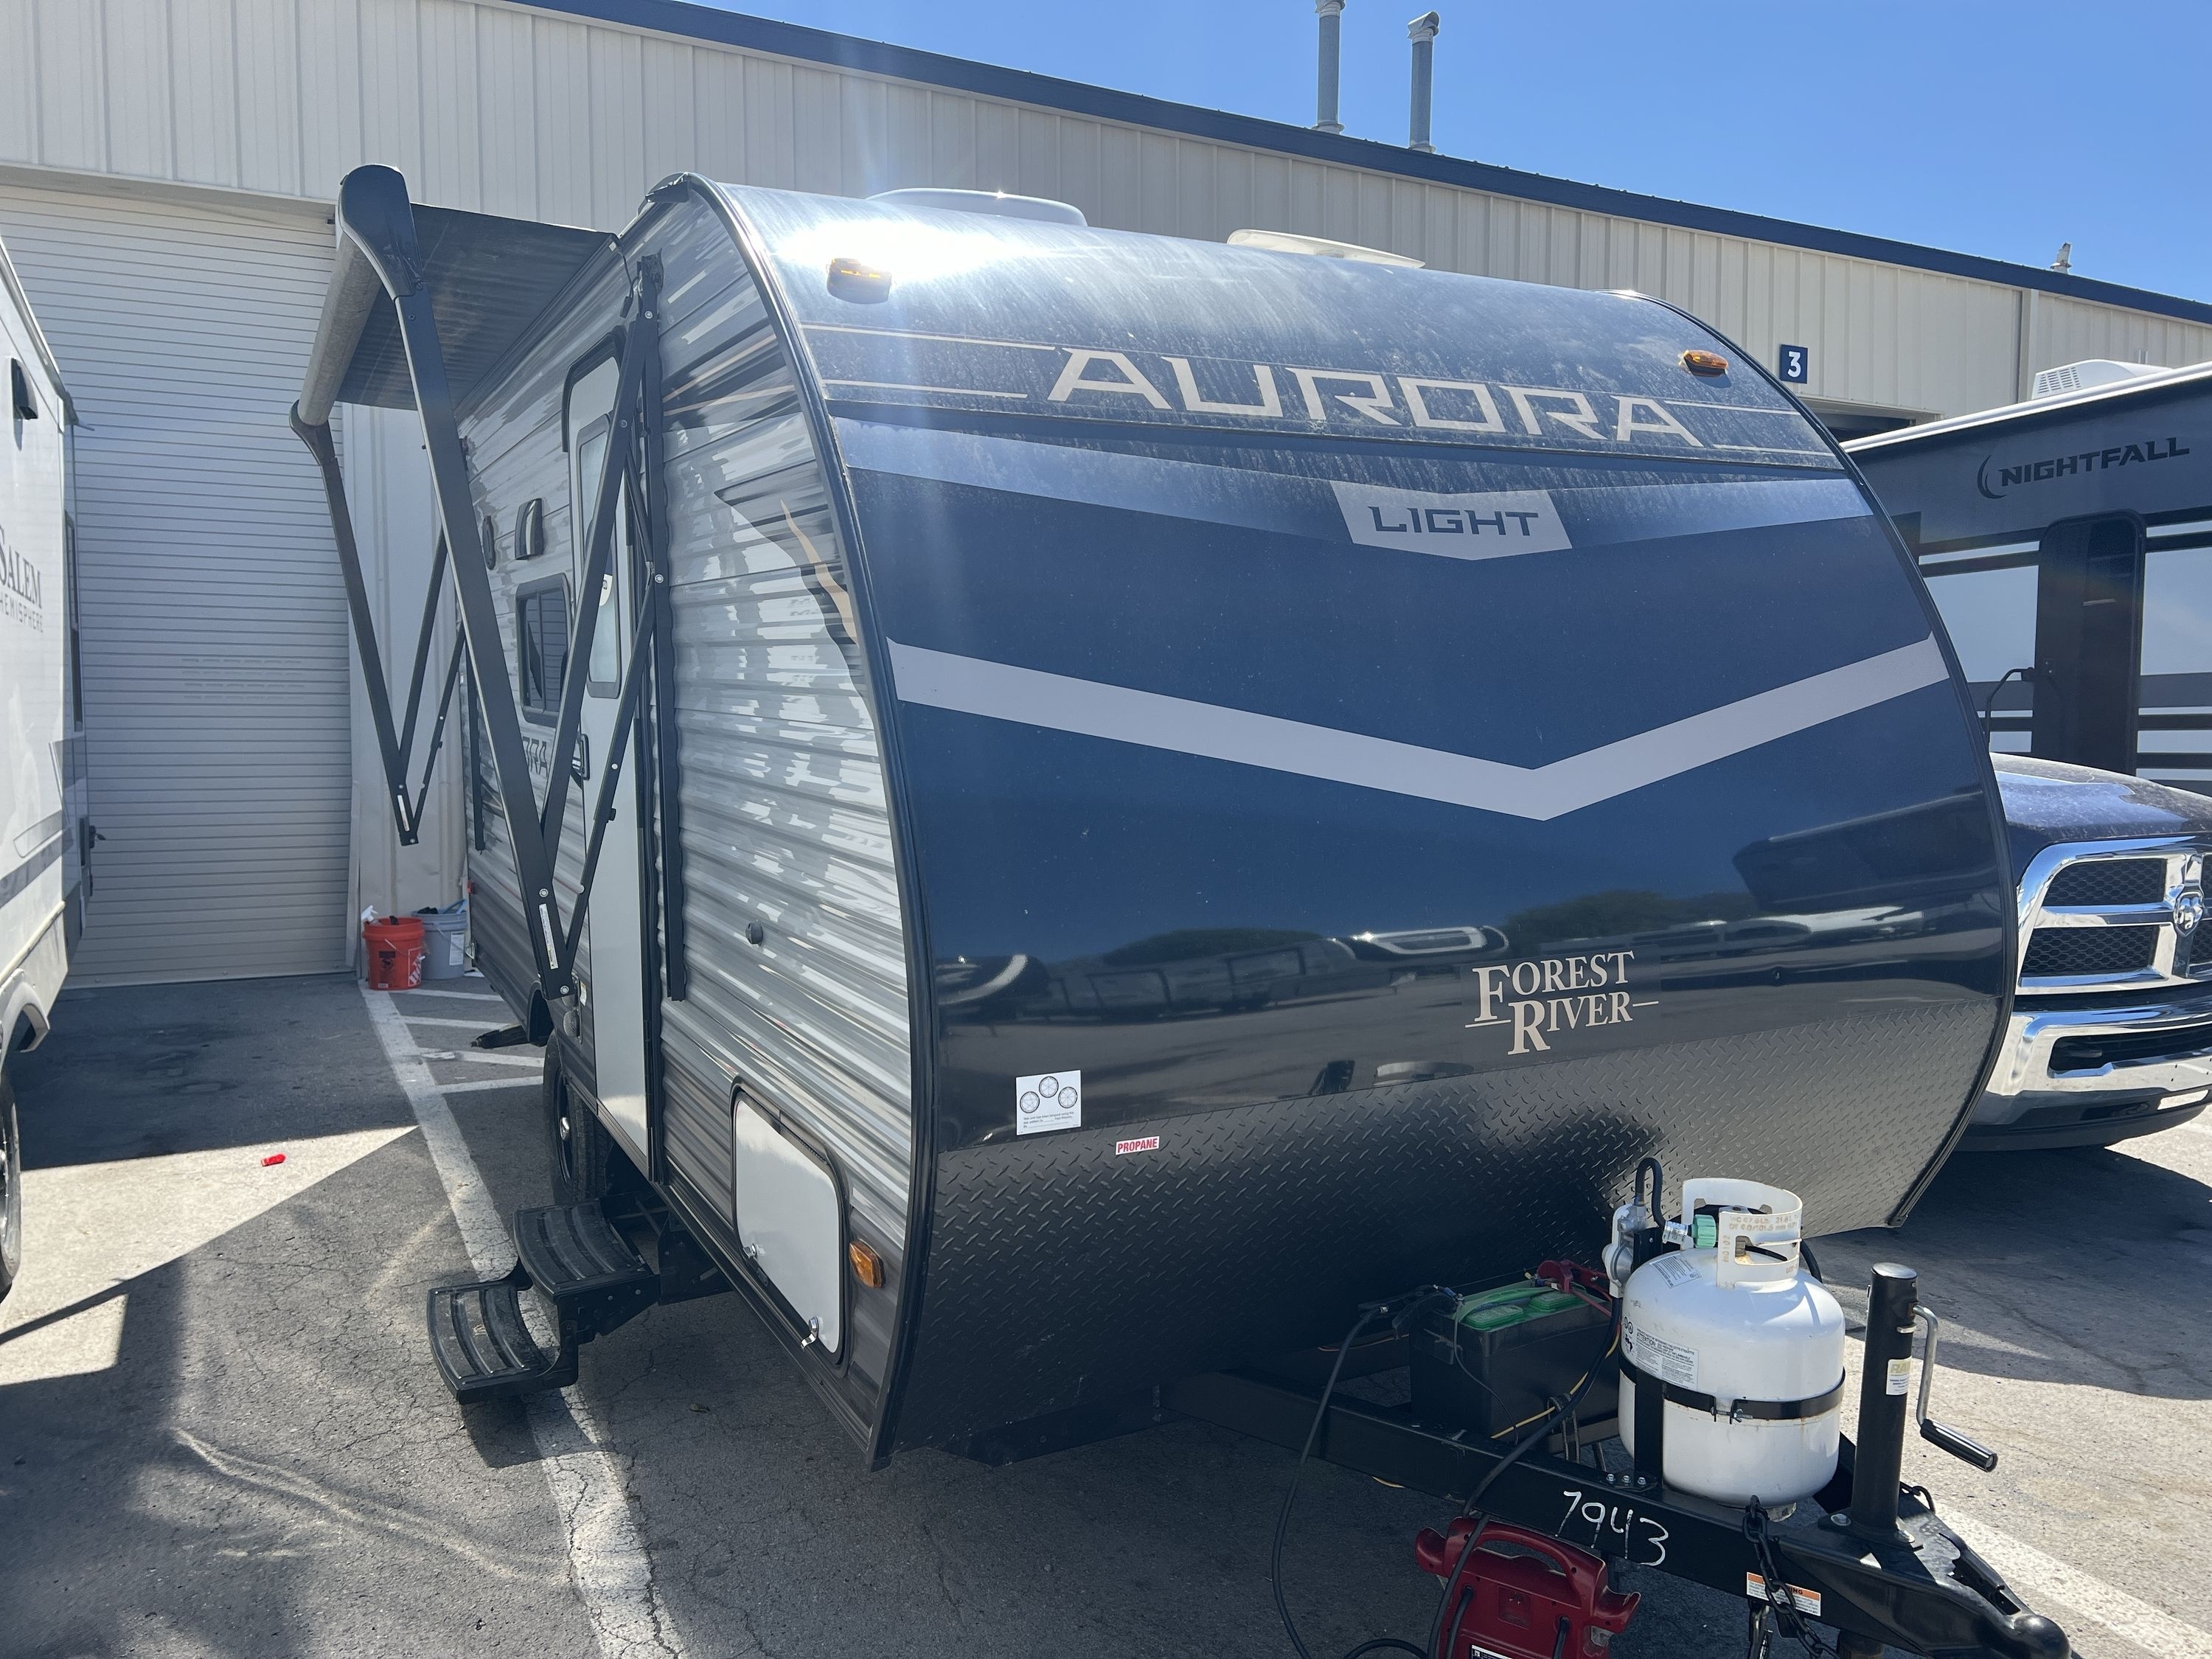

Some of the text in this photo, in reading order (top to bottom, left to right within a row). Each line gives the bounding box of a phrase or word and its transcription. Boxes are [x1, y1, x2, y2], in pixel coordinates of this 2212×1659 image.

[1787, 351, 1801, 378] 3
[1047, 348, 1704, 448] AURORA
[1998, 437, 2190, 487] NIGHTFALL
[1368, 507, 1539, 536] LIGHT
[1472, 950, 1635, 1022] FOREST
[1508, 992, 1633, 1055] RIVER
[1117, 1138, 1158, 1153] PROPANE
[1555, 1490, 1669, 1566] 7943
